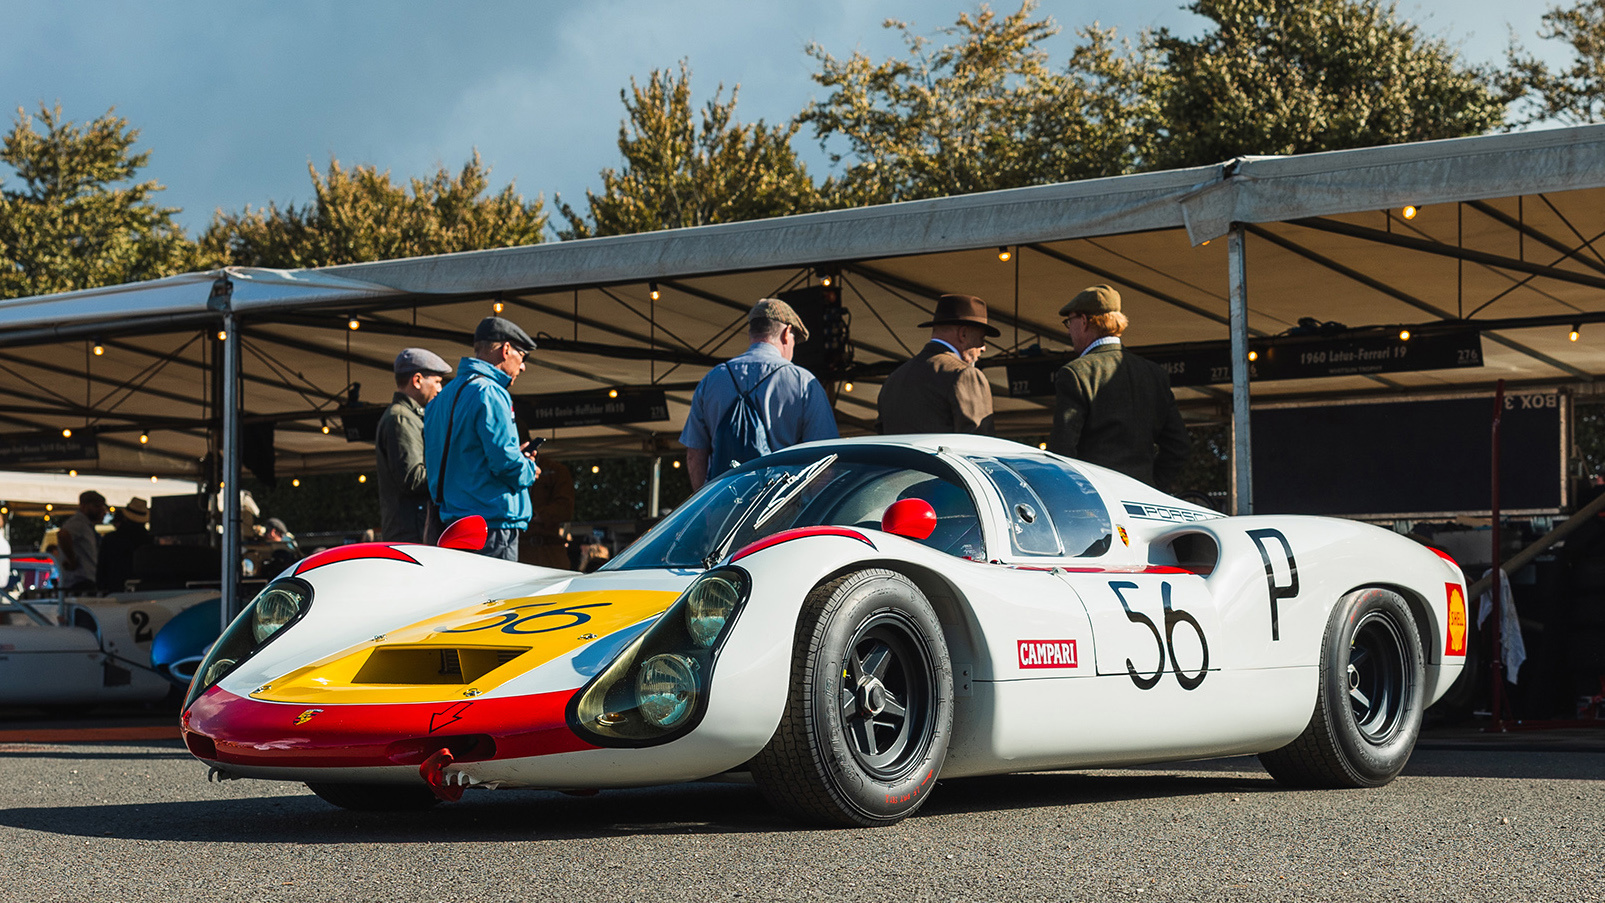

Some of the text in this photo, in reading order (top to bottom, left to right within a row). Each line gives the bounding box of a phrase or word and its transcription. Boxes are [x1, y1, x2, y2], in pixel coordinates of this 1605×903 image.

[1301, 351, 1327, 365] 1960
[1394, 345, 1407, 358] 19
[1457, 349, 1478, 360] 276
[1211, 366, 1229, 378] 277
[1504, 394, 1557, 410] BOX 3
[1245, 527, 1300, 641] P
[130, 610, 153, 643] 2
[433, 602, 613, 635] 56
[1451, 611, 1464, 626] SHELL
[1108, 580, 1210, 691] 56
[1020, 642, 1075, 666] CAMPARI
